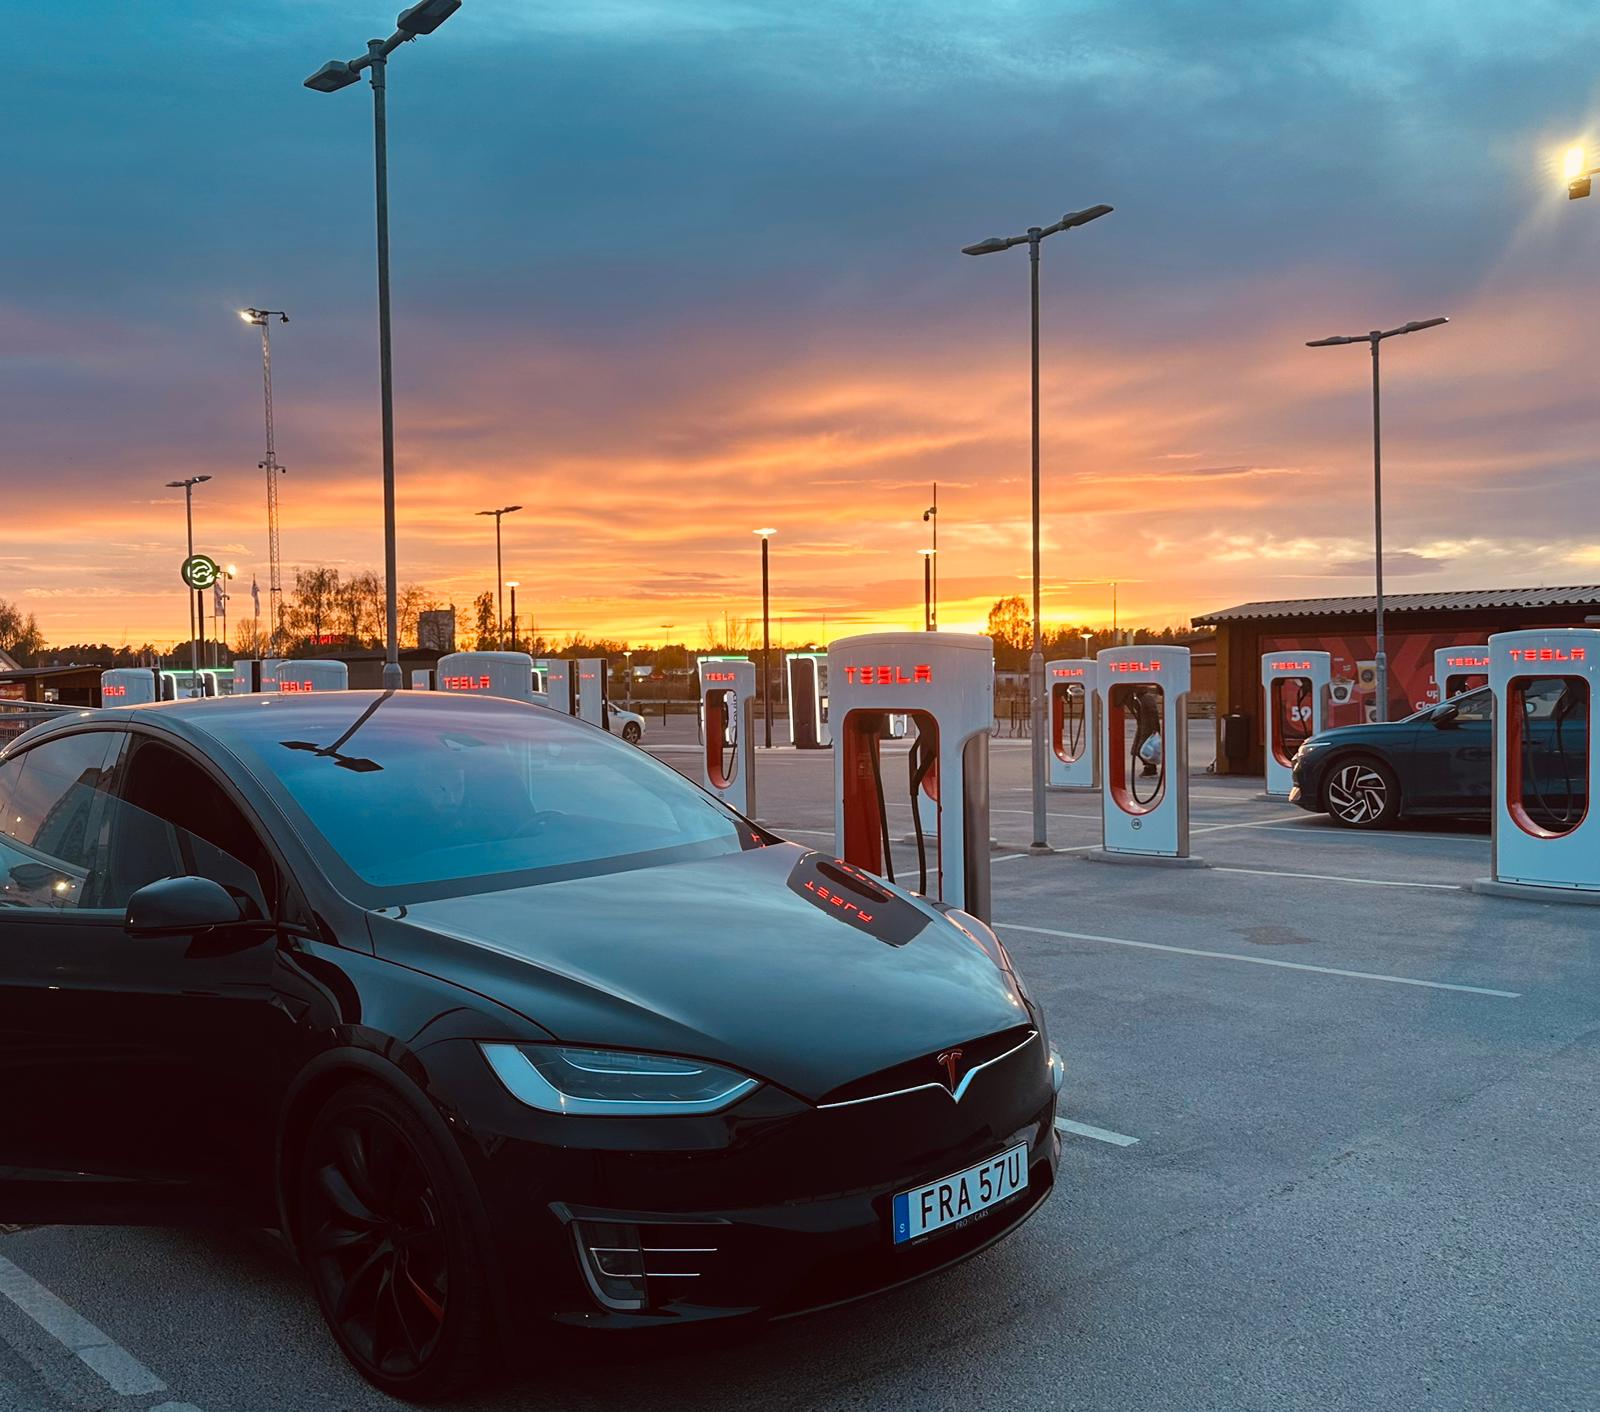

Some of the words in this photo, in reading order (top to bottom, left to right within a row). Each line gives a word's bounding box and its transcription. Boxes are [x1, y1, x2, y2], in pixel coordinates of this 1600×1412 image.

[1510, 648, 1586, 662] TESLA
[1109, 661, 1162, 673] TESLA
[1271, 661, 1312, 670] TESLA
[1447, 658, 1489, 667] TESLA
[704, 672, 737, 681] TESLA
[843, 663, 933, 685] TESLA
[1052, 669, 1085, 677] TESLA
[279, 681, 313, 692] TESLA
[442, 675, 491, 690] TESLA
[921, 1177, 972, 1229] FRA
[979, 1153, 1020, 1203] 57U
[899, 1223, 907, 1234] S
